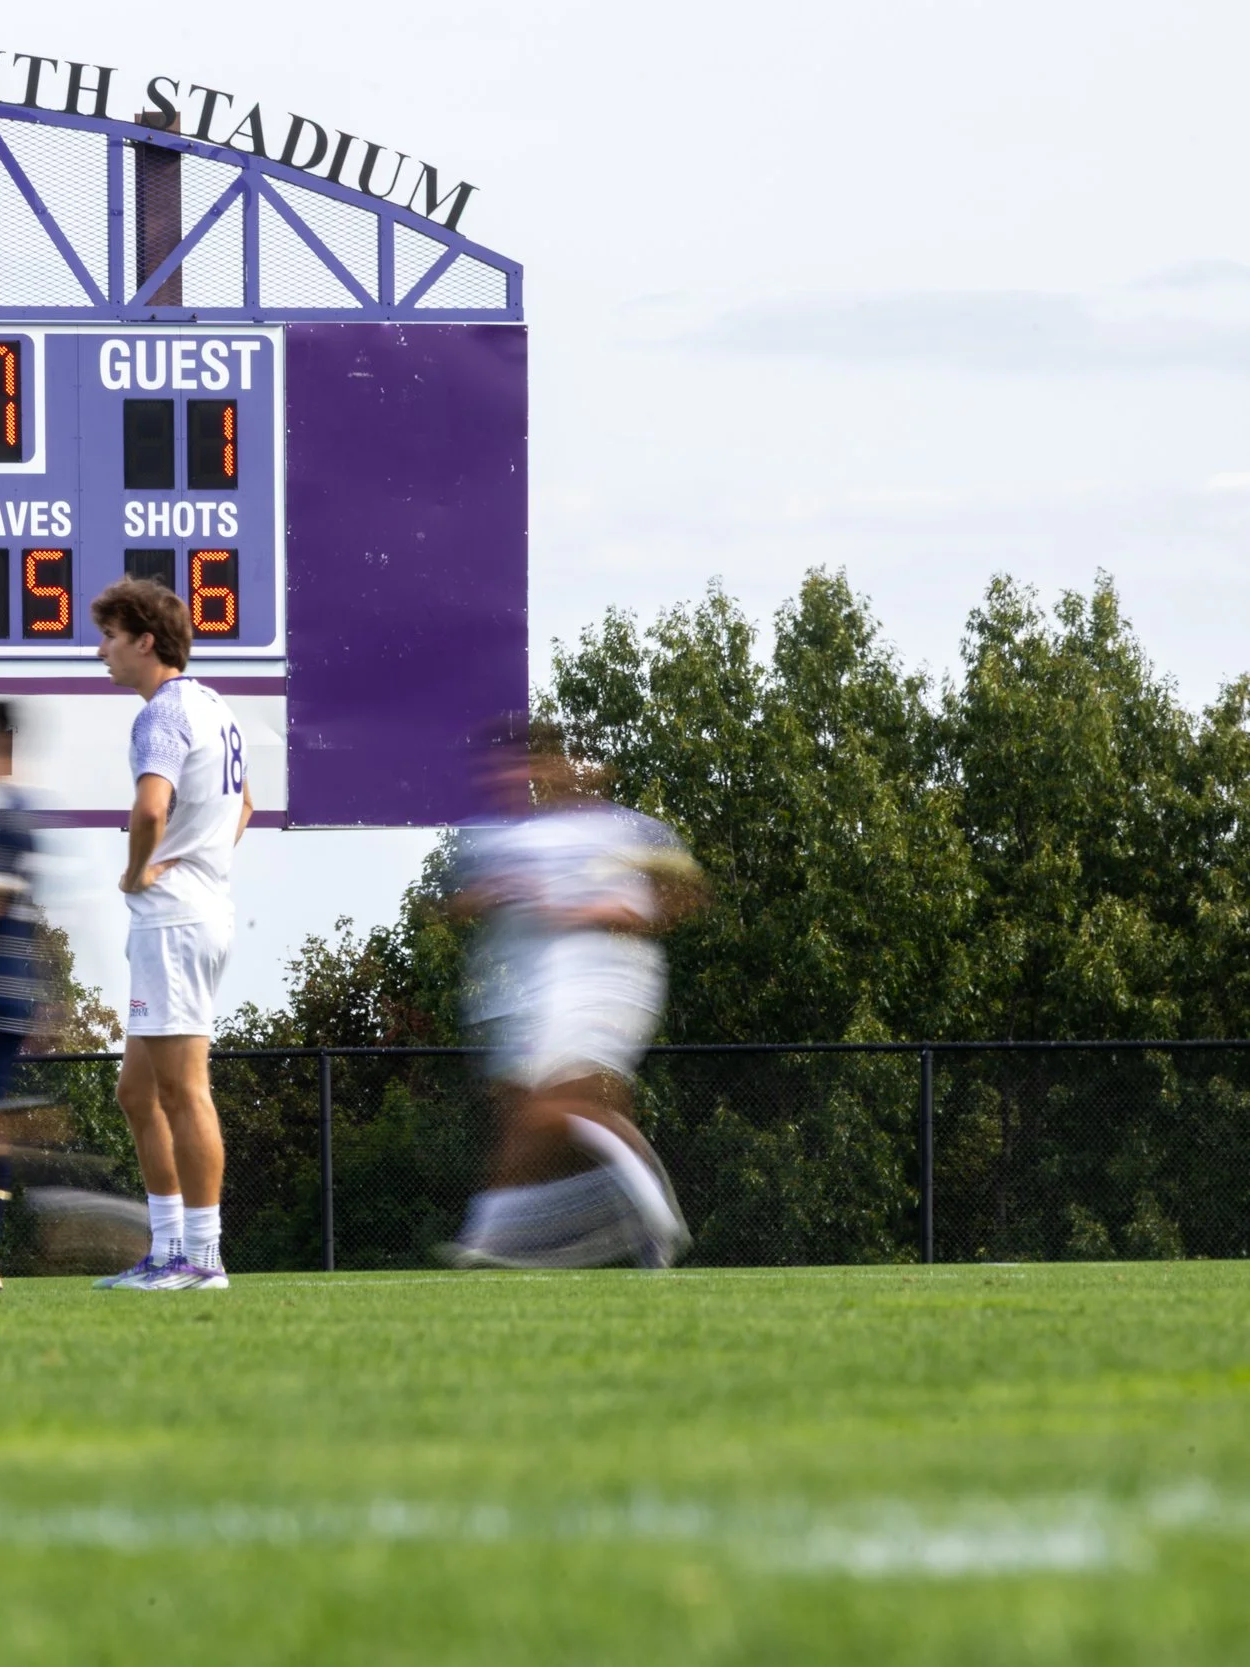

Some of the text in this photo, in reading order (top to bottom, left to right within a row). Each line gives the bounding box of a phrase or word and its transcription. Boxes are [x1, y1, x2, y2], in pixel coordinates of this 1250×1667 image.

[141, 76, 480, 236] STADIUM
[99, 339, 261, 391] GUEST
[223, 406, 234, 477] 1
[124, 500, 239, 538] SHOTS
[26, 550, 69, 631] 5
[192, 550, 236, 632] 6
[220, 722, 243, 796] 18
